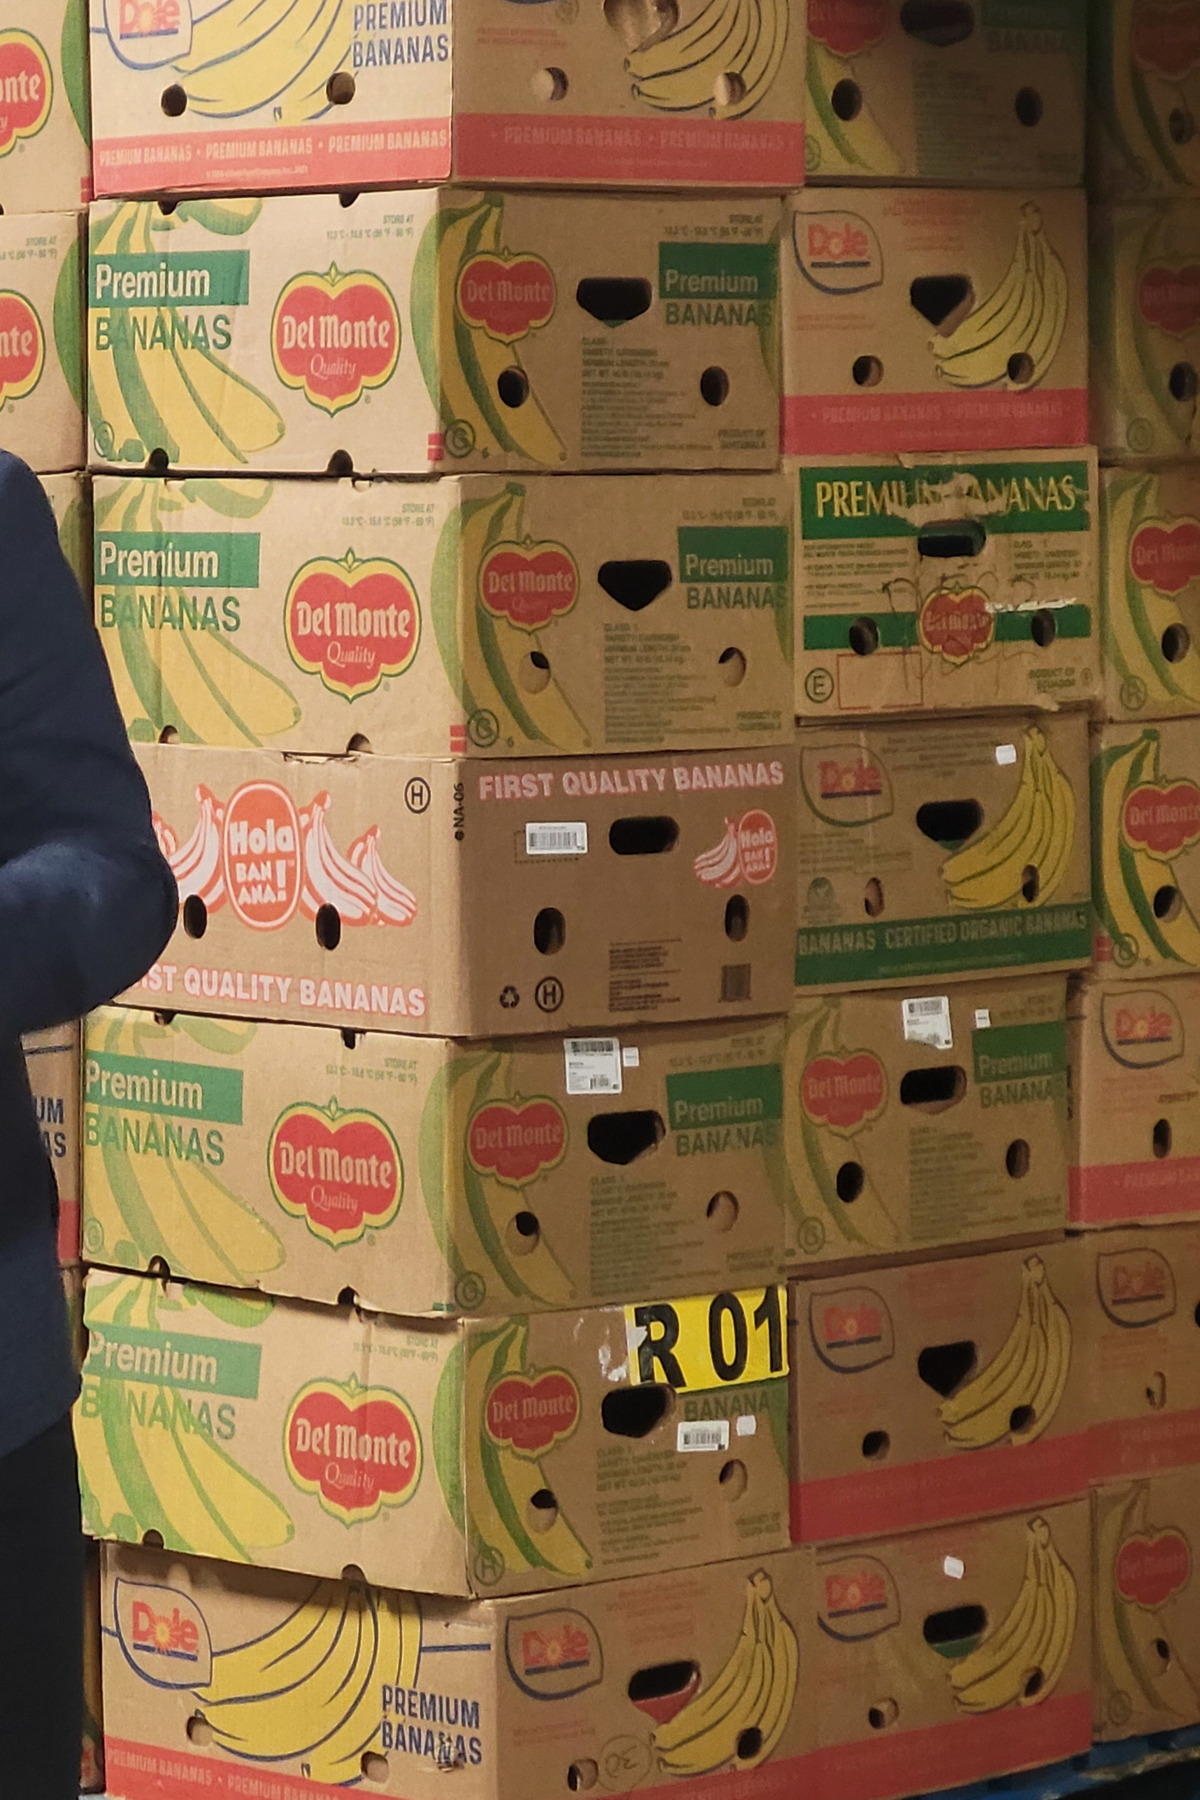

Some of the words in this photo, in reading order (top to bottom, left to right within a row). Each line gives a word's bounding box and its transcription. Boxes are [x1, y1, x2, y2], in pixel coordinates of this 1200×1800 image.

[352, 0, 448, 32] PREMIUM
[352, 33, 450, 68] BANANAS
[100, 146, 143, 167] PREMIUM
[149, 143, 193, 164] BANANAS
[205, 141, 256, 161] PREMIUM
[258, 137, 313, 158] BANANAS
[328, 132, 385, 154] PREMIUM
[386, 129, 448, 150] BANANAS
[806, 222, 870, 258] Dole
[95, 262, 211, 300] Premium
[466, 279, 496, 302] Del
[496, 278, 551, 303] Monte
[664, 269, 760, 295] Premium
[94, 313, 233, 351] BANANAS
[281, 315, 315, 350] Del
[319, 314, 392, 350] Monte
[310, 353, 357, 380] Quality
[99, 540, 219, 579] Premium
[684, 553, 775, 578] Premium
[487, 570, 516, 594] Del
[517, 569, 574, 594] Monte
[100, 593, 241, 634] BANANAS
[296, 601, 331, 637] Del
[335, 601, 411, 638] Monte
[326, 641, 376, 670] Quality
[478, 772, 553, 801] FIRST
[562, 767, 667, 797] QUALITY
[673, 760, 785, 792] BANANAS
[229, 818, 295, 856] Hola
[799, 929, 877, 957] BANANAS
[884, 922, 957, 950] CERTIFIED
[960, 915, 1023, 943] ORGANIC
[185, 966, 293, 1003] QUALITY
[300, 978, 427, 1018] BANANAS
[978, 1051, 1054, 1076] Premium
[85, 1058, 204, 1111] Premium
[808, 1075, 832, 1098] Del
[832, 1072, 882, 1097] Monte
[673, 1096, 764, 1124] Premium
[84, 1110, 226, 1167] BANANAS
[474, 1127, 504, 1151] Del
[505, 1122, 562, 1149] Monte
[279, 1140, 315, 1179] Del
[318, 1146, 393, 1190] Monte
[310, 1183, 360, 1214] Quality
[634, 1302, 687, 1389] R
[708, 1284, 785, 1383] 01
[87, 1330, 218, 1385] Premium
[492, 1400, 519, 1424] Del
[521, 1394, 575, 1421] Monte
[295, 1416, 331, 1456] Del
[335, 1423, 412, 1469] Monte
[324, 1461, 376, 1493] Quality
[132, 1600, 200, 1653] Dole
[382, 1684, 481, 1731] PREMIUM
[381, 1719, 483, 1766] BANANAS
[107, 1745, 158, 1774] PREMIUM
[159, 1758, 213, 1787] BANANAS
[227, 1771, 281, 1799] PREMIUM
